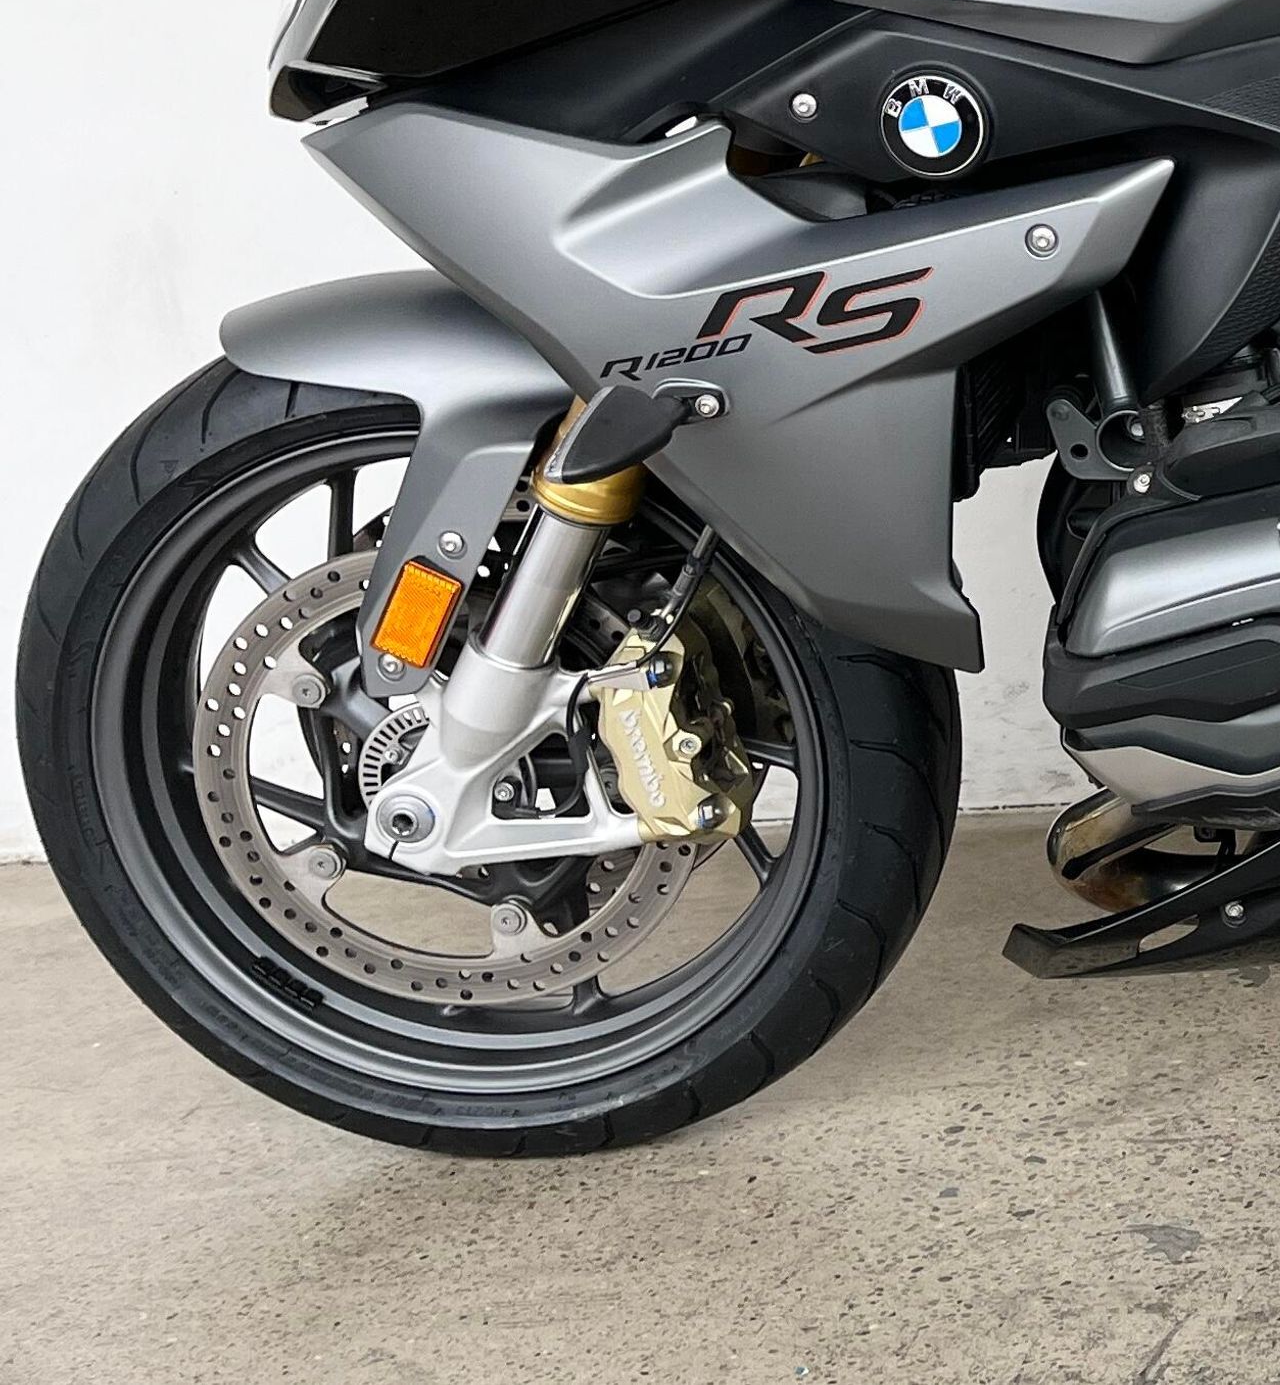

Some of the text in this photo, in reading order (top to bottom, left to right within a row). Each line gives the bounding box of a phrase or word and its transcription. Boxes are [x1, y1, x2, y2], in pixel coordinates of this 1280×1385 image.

[884, 77, 963, 119] BMW
[695, 265, 935, 355] RS
[599, 333, 753, 382] R1200
[619, 708, 667, 808] brembo
